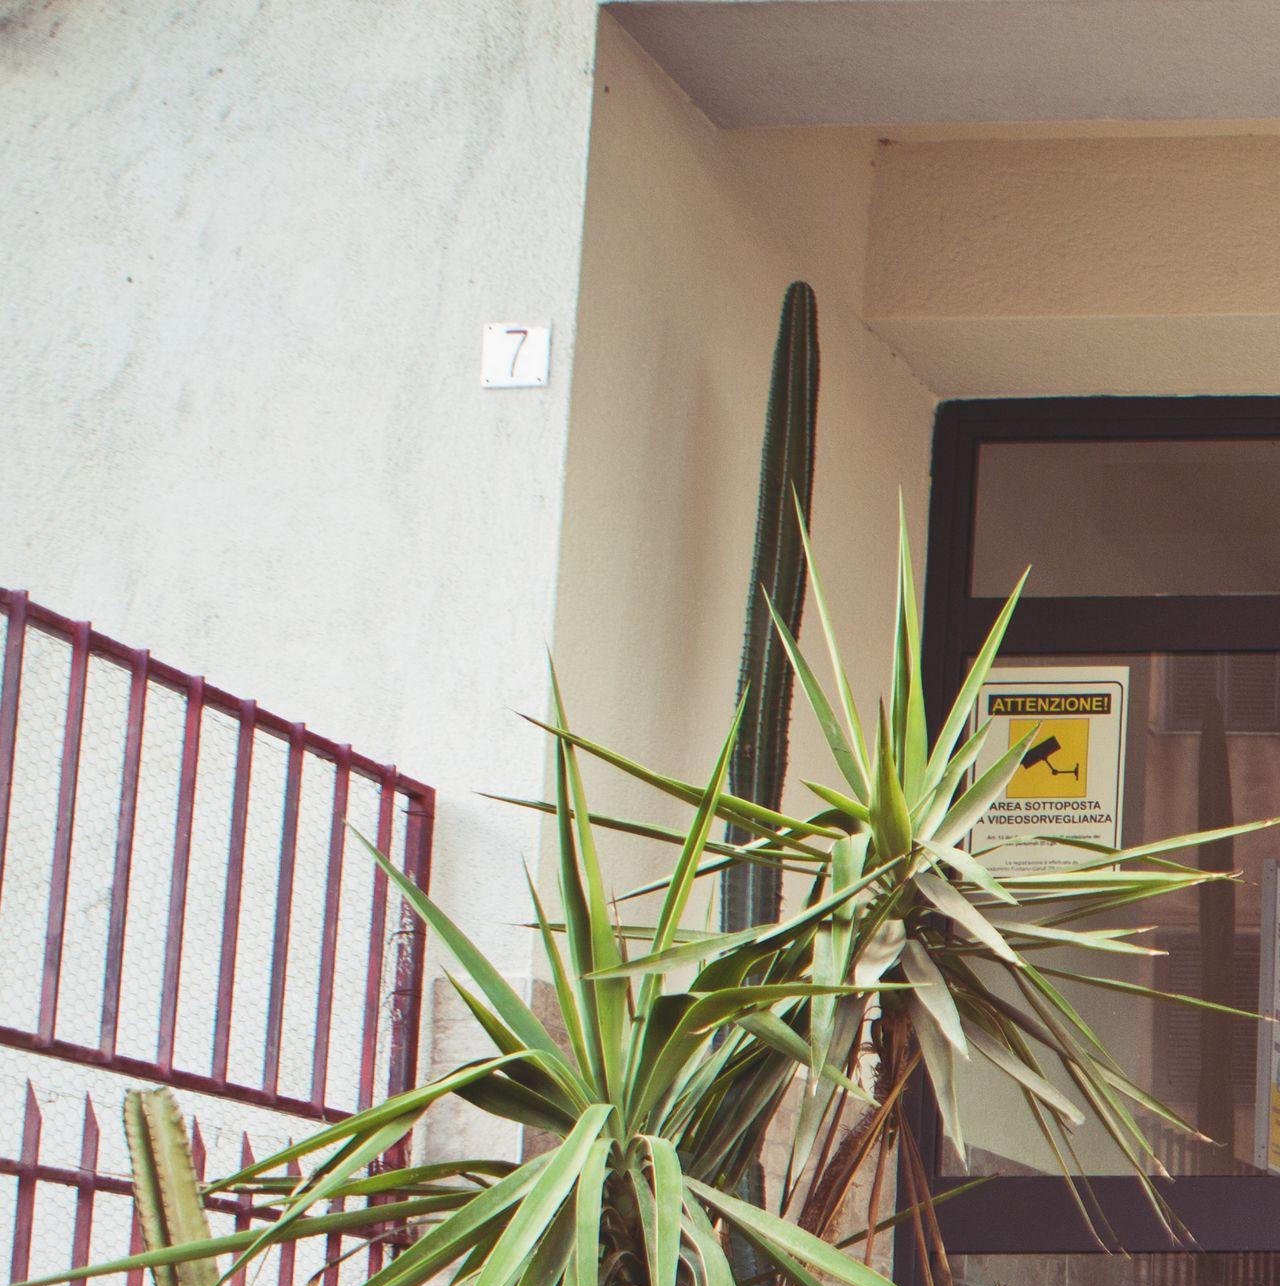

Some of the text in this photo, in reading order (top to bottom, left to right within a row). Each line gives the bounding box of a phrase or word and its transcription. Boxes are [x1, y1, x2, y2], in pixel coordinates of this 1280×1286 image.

[505, 329, 528, 378] 7
[992, 696, 1108, 713] ATTENZIONE!
[989, 800, 1101, 811] AREA SOTTOPOSTA
[976, 813, 1113, 825] A VIDEOSORVEGLIANZA
